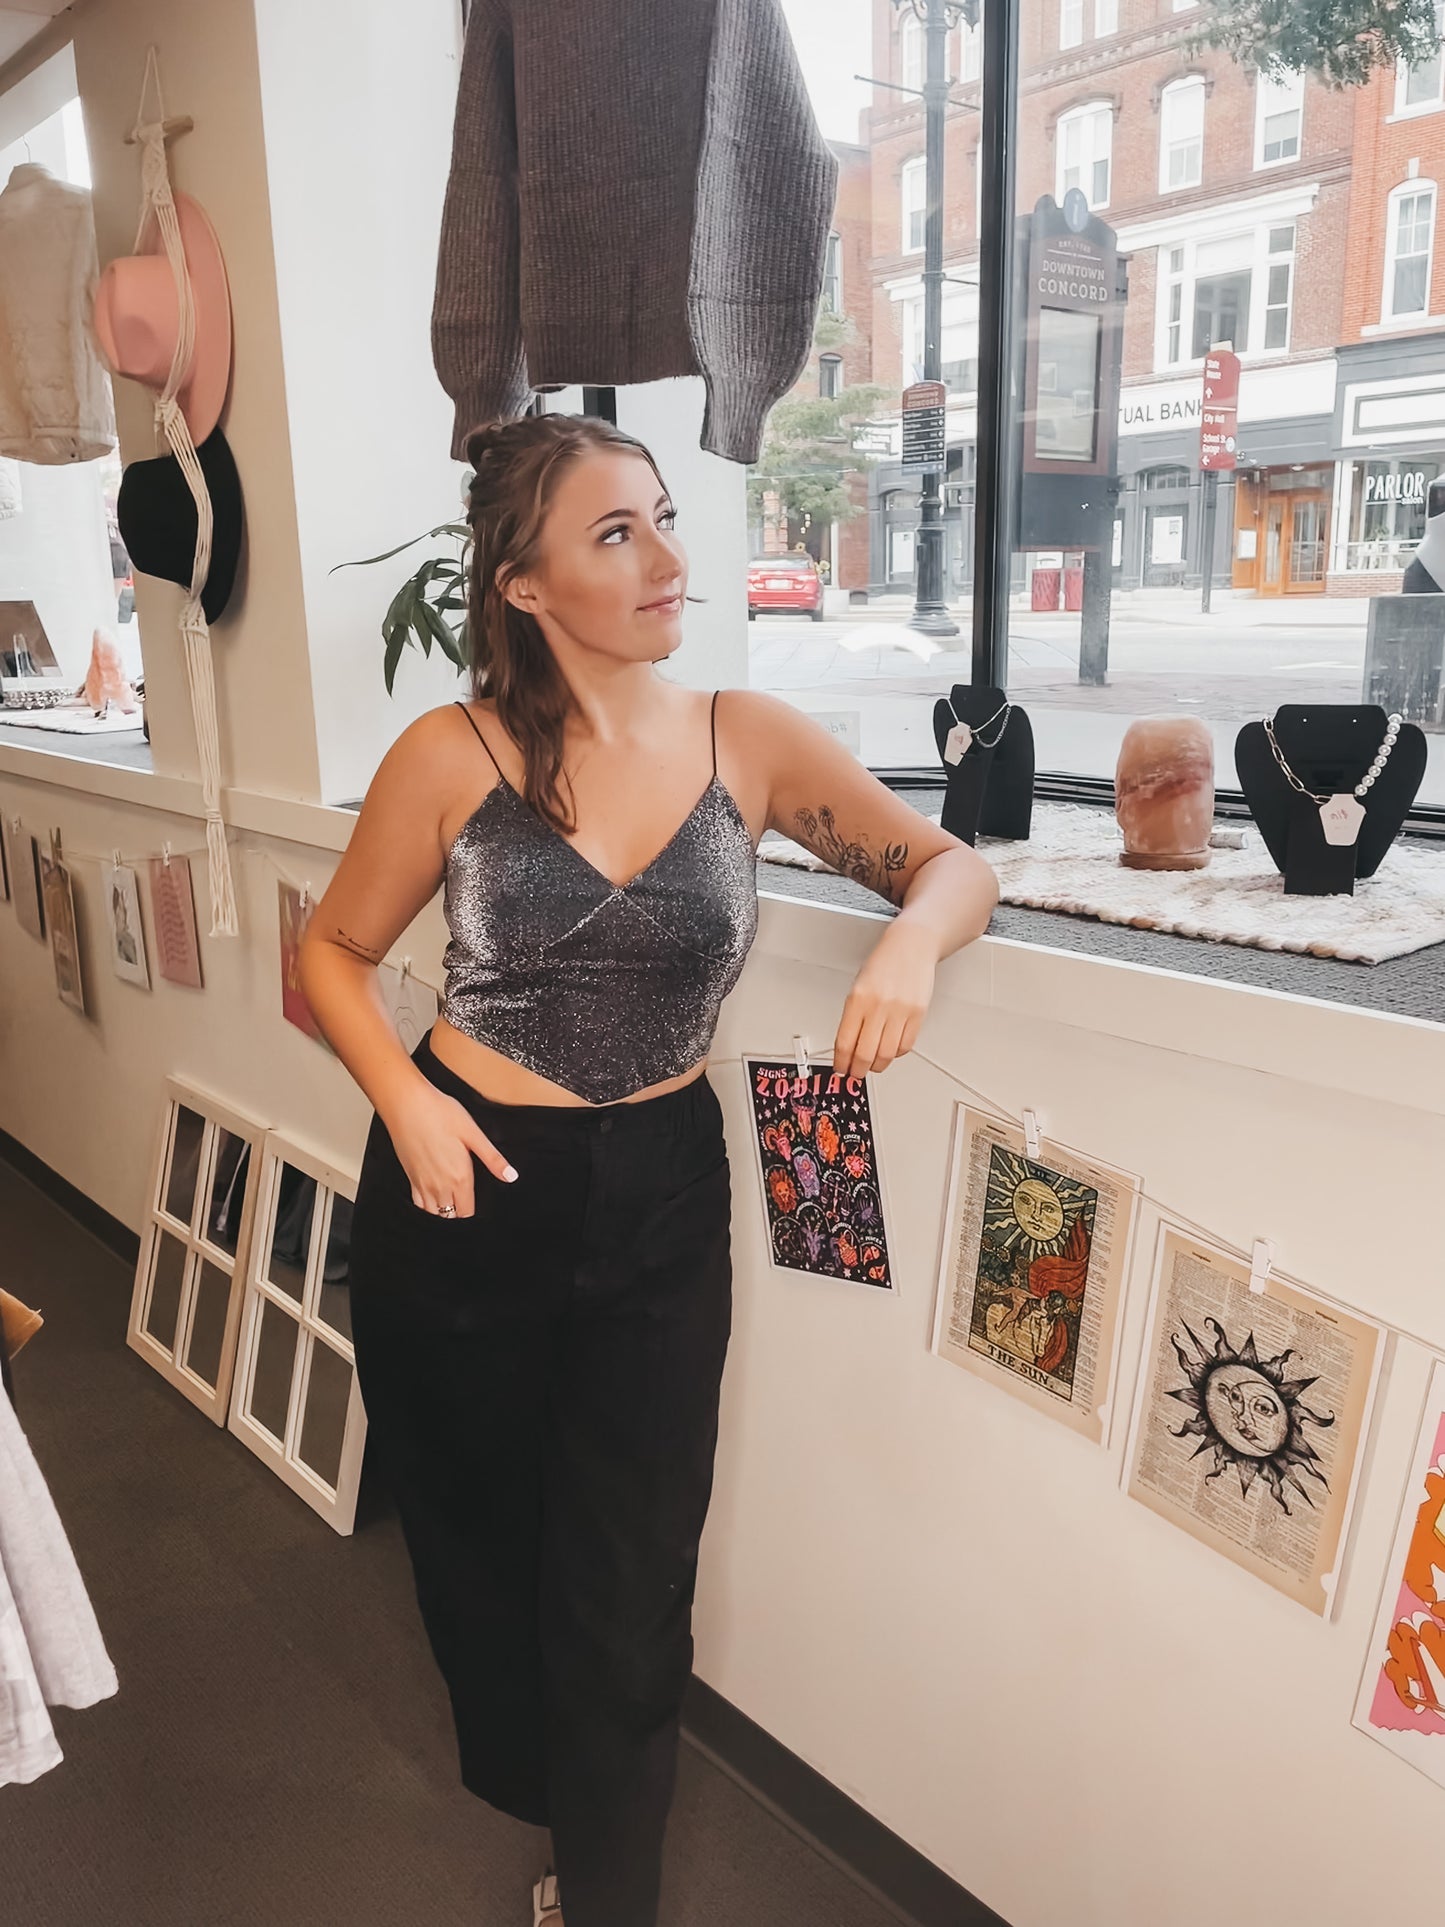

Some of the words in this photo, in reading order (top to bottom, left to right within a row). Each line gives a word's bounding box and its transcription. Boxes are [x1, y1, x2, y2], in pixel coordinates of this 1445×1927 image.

[1042, 260, 1105, 280] DOWNTOWN
[1038, 278, 1108, 301] CONCORD
[1119, 404, 1154, 424] UAL
[1365, 471, 1425, 501] PARLOR
[1401, 496, 1424, 505] salon
[757, 1066, 787, 1079] SIGNS
[756, 1072, 863, 1099] ZODIAC
[987, 1344, 1015, 1367] THE
